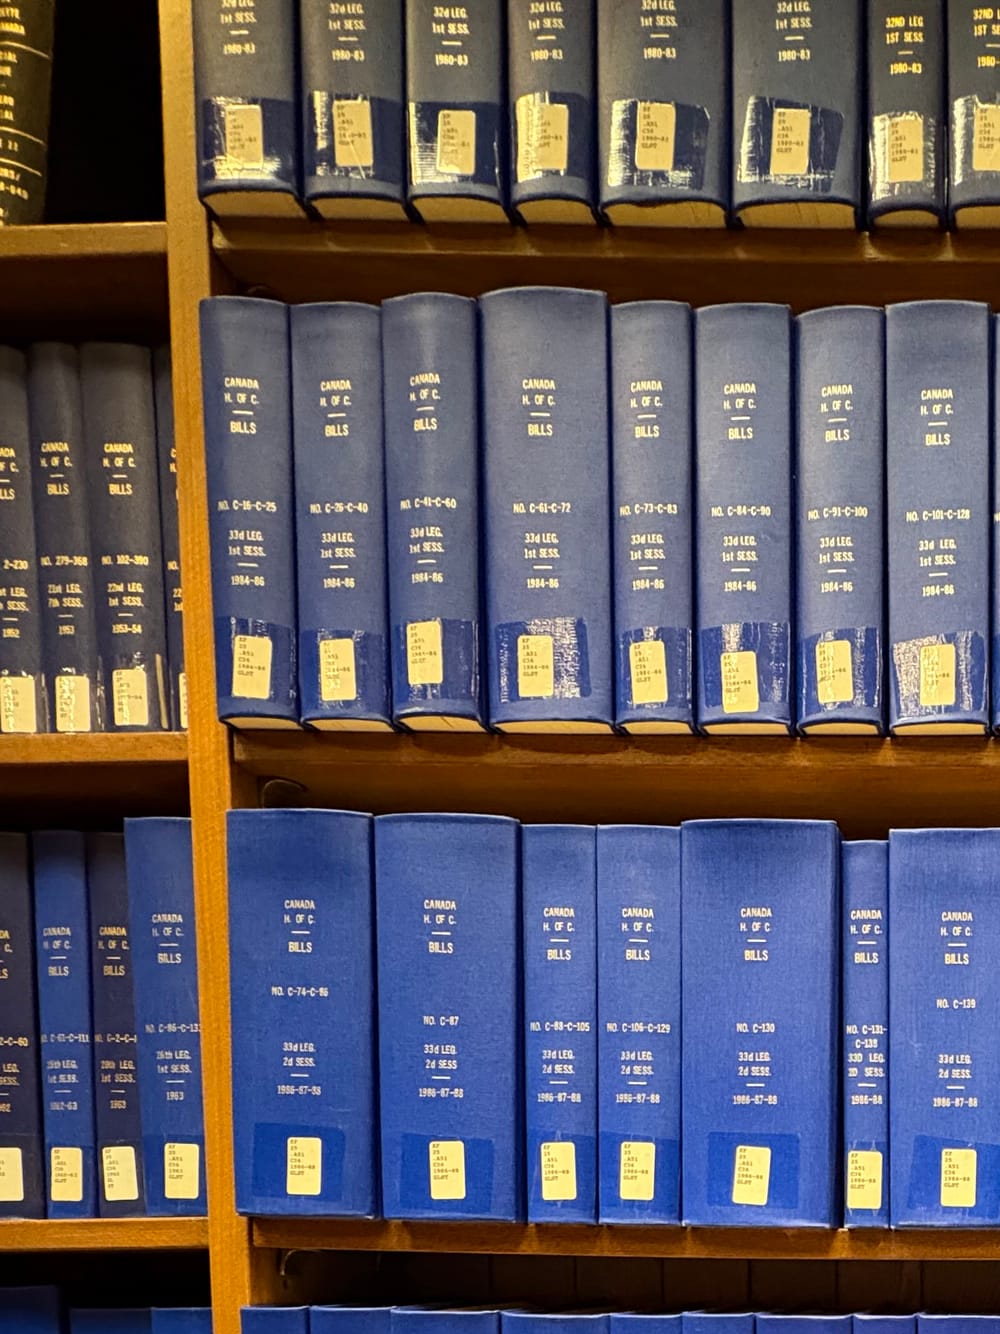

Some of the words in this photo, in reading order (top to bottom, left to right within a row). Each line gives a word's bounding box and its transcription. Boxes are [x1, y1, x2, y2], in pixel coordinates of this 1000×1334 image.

[523, 379, 555, 390] CANADA
[724, 383, 756, 394] CANADA
[535, 395, 544, 405] OF
[735, 398, 745, 408] OF
[528, 424, 553, 436] BILLS
[729, 427, 753, 440] BILLS
[514, 503, 526, 513] NO.
[711, 506, 724, 517] NO.
[525, 533, 540, 543] 33d
[723, 536, 738, 546] 33d
[525, 549, 536, 558] 1st
[722, 552, 734, 562] 1st
[424, 900, 456, 910] CANADA
[436, 915, 445, 924] OF
[429, 942, 453, 953] BILLS
[423, 1016, 435, 1025] NO.
[440, 1016, 459, 1026] C-87
[424, 1044, 439, 1054] 33d
[426, 1059, 435, 1068] 2d
